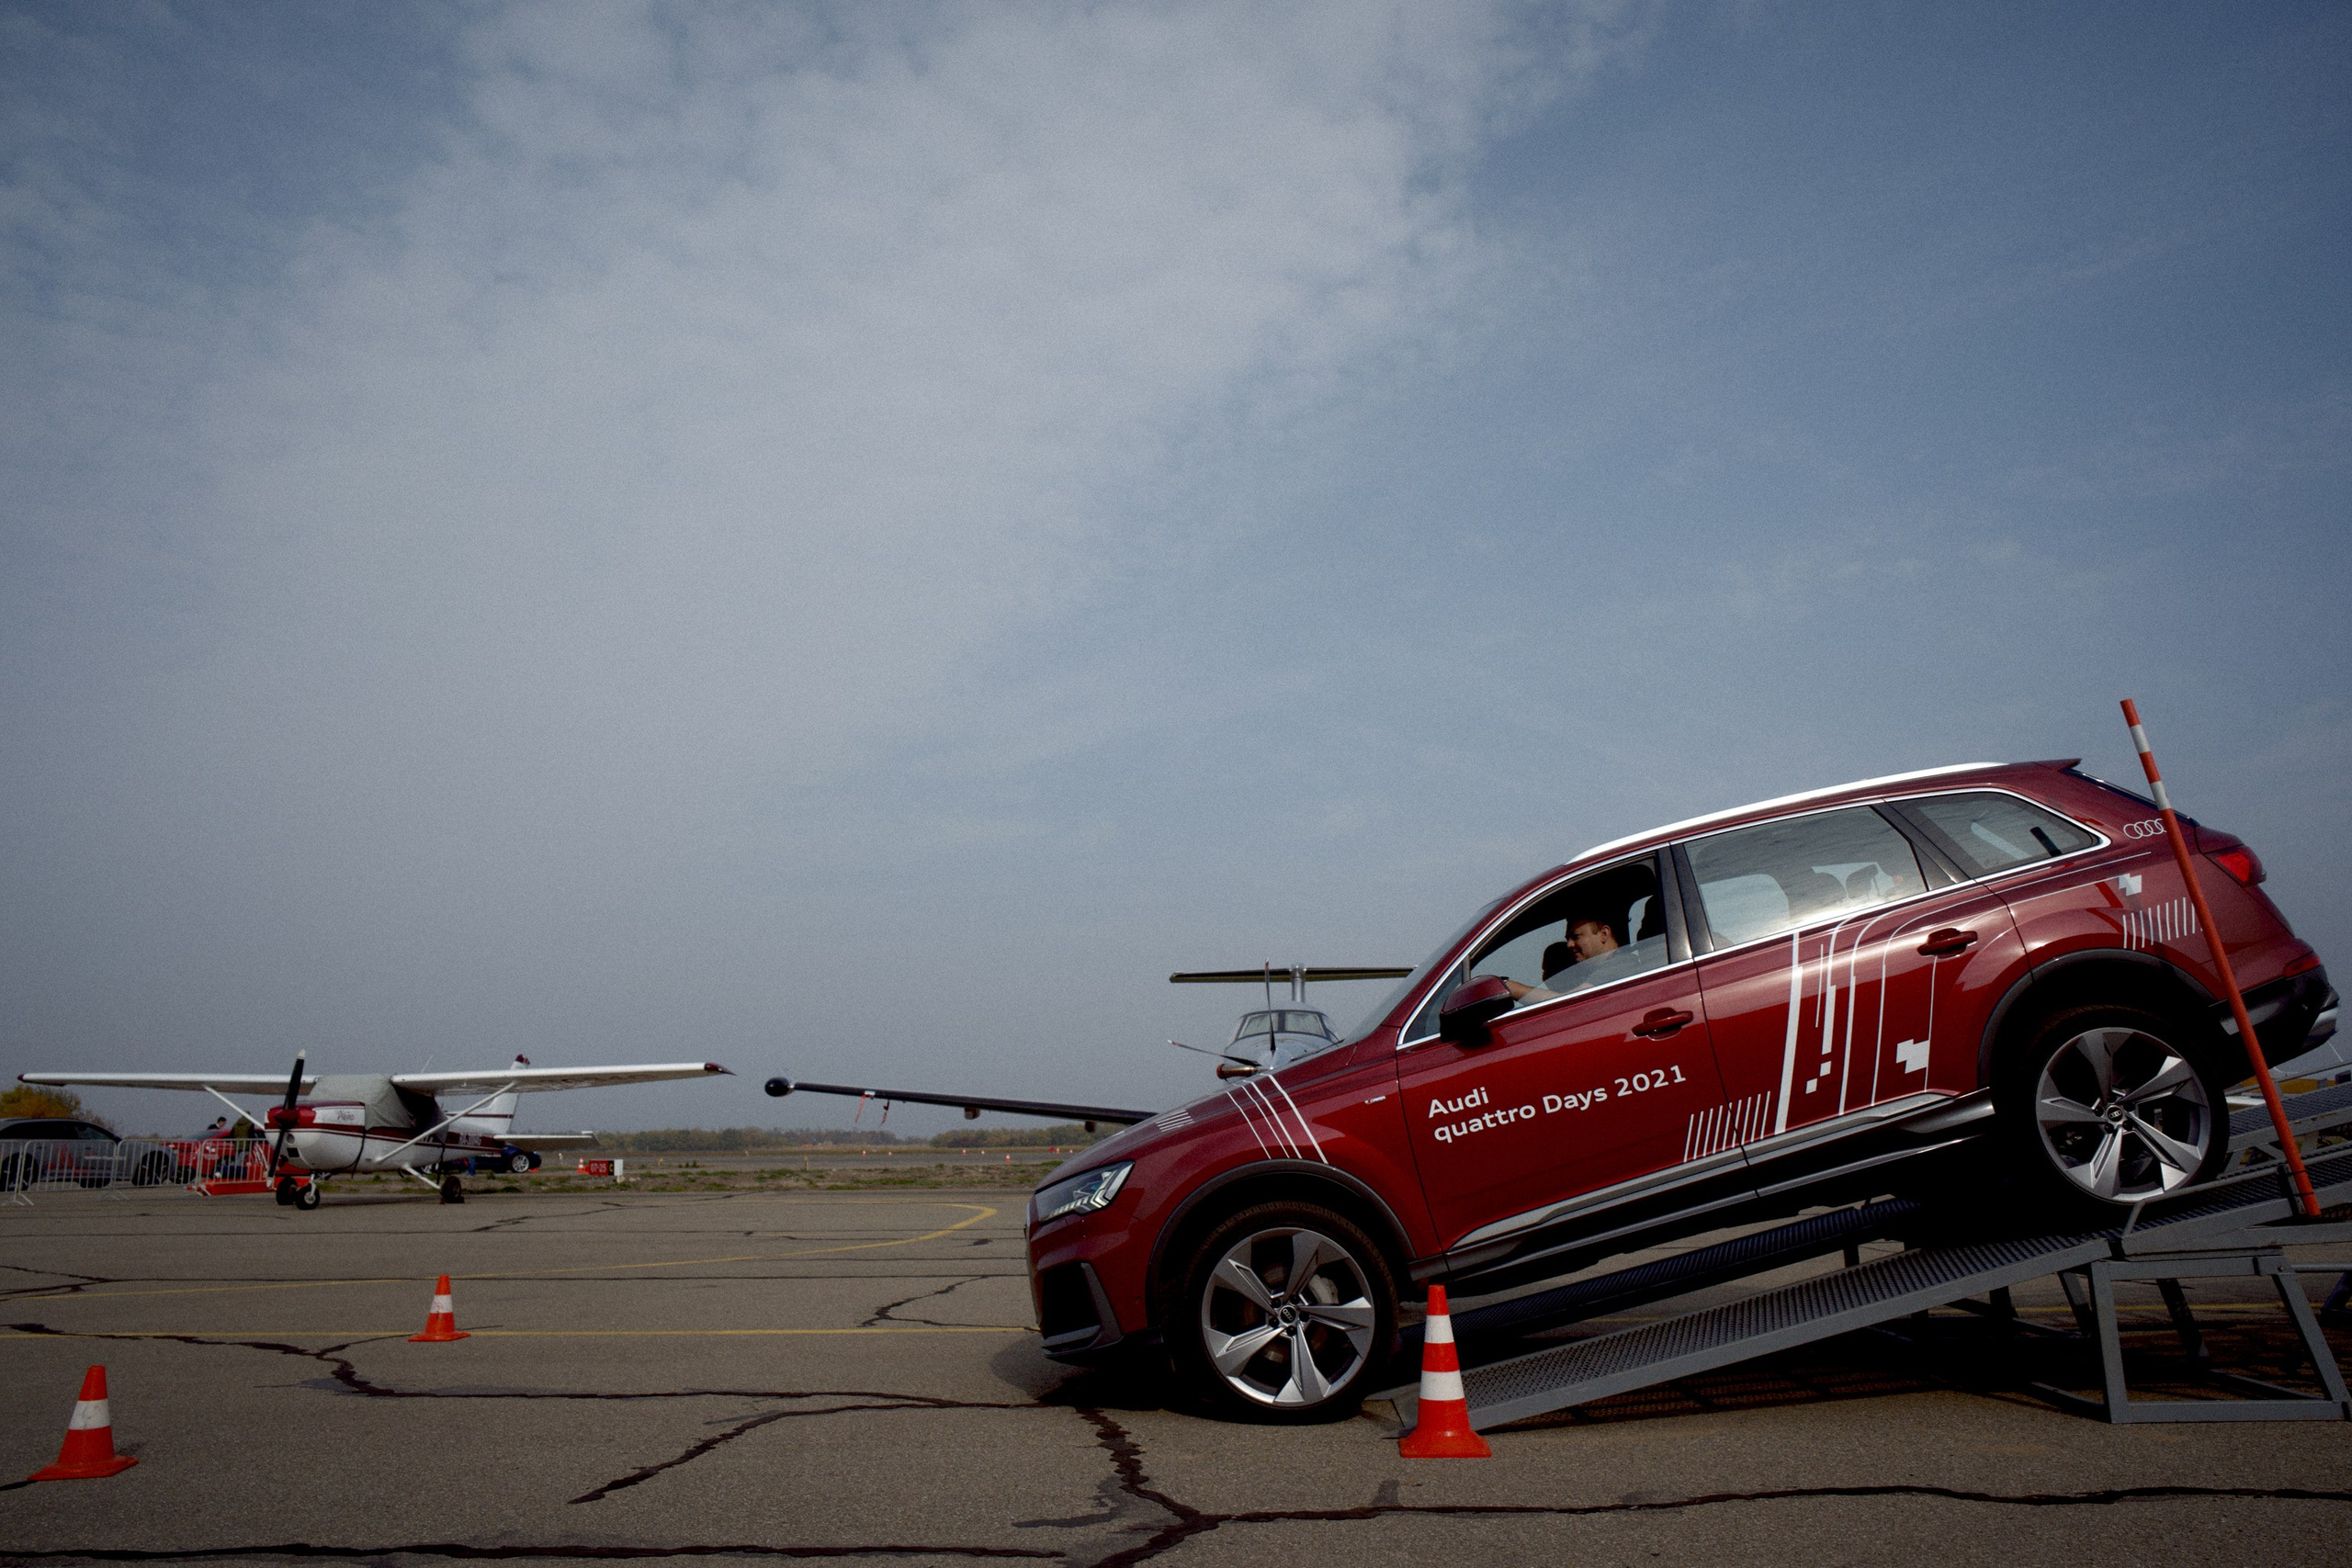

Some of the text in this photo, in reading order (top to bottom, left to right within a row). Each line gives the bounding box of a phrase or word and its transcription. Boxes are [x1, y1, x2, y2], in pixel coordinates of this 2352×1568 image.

[1429, 1087, 1489, 1118] Audi
[1433, 1065, 1687, 1144] quattro Days 2021
